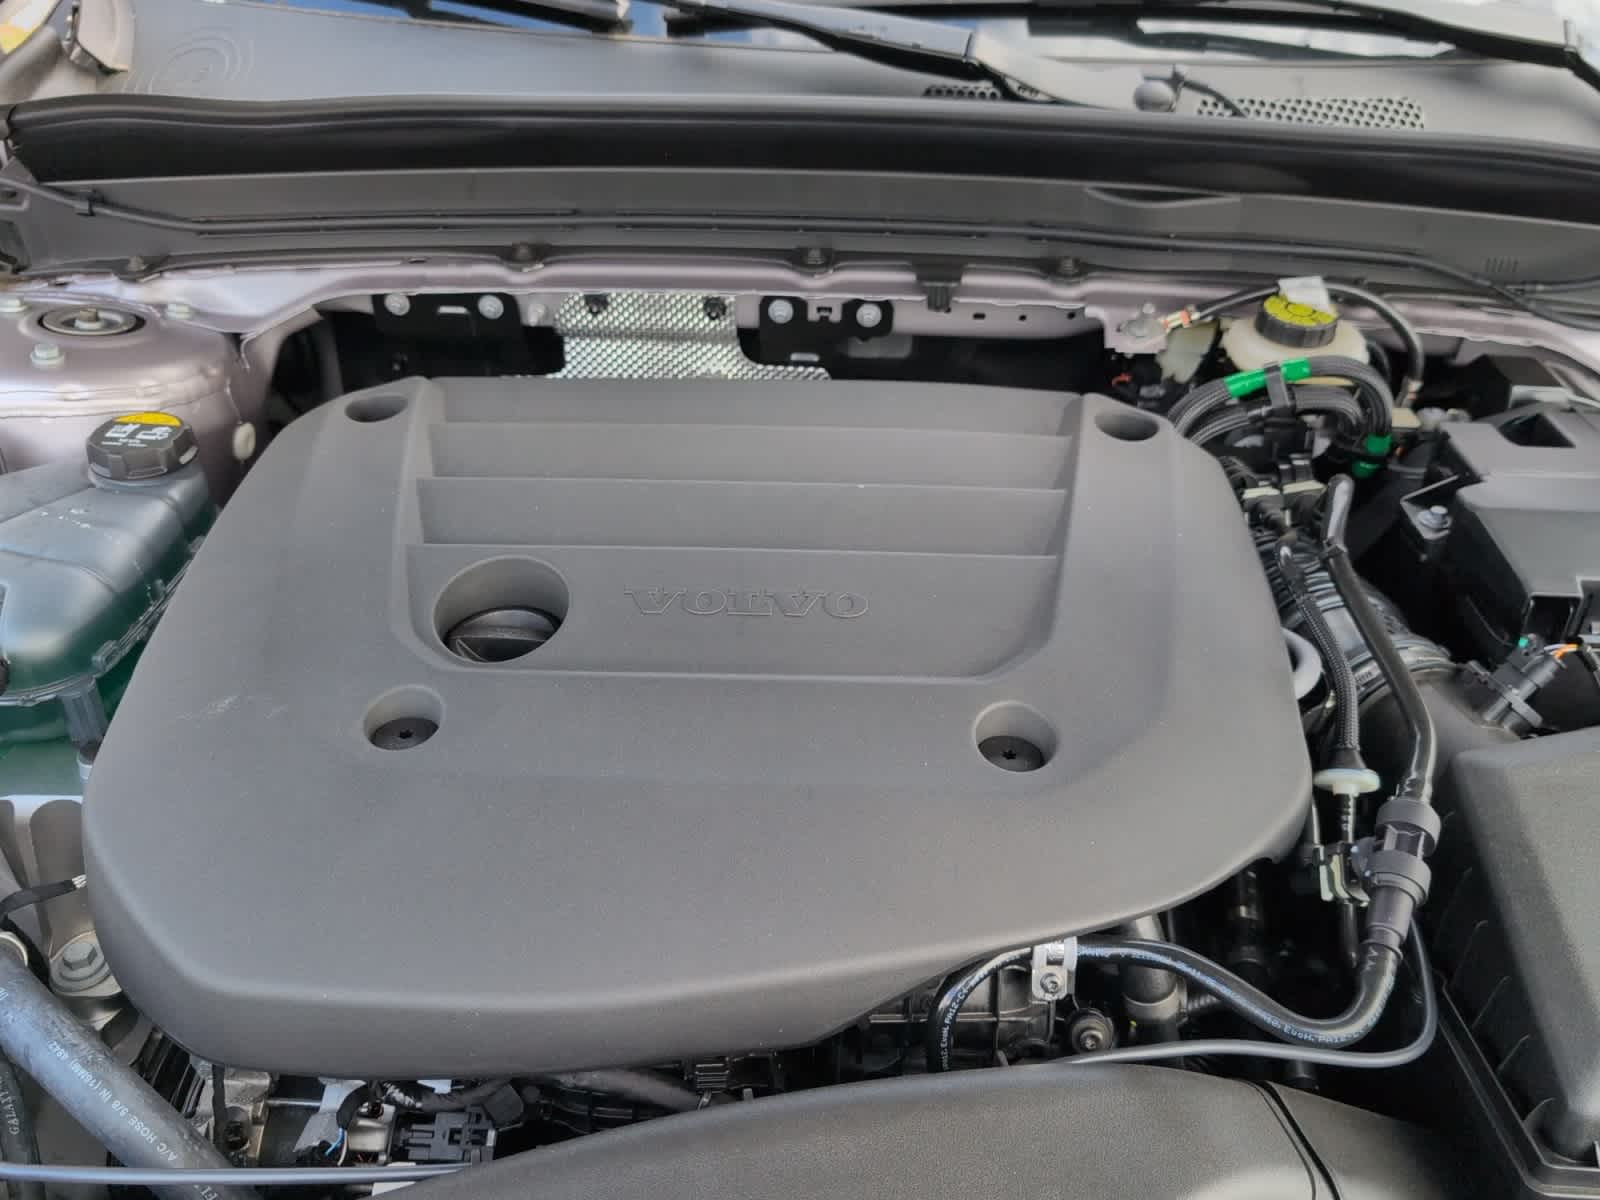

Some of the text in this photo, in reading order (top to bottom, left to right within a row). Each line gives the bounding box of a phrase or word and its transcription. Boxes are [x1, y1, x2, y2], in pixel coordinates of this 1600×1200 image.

[623, 587, 869, 618] VOLVO
[128, 1115, 157, 1144] HOSE
[156, 1142, 177, 1161] A/C
